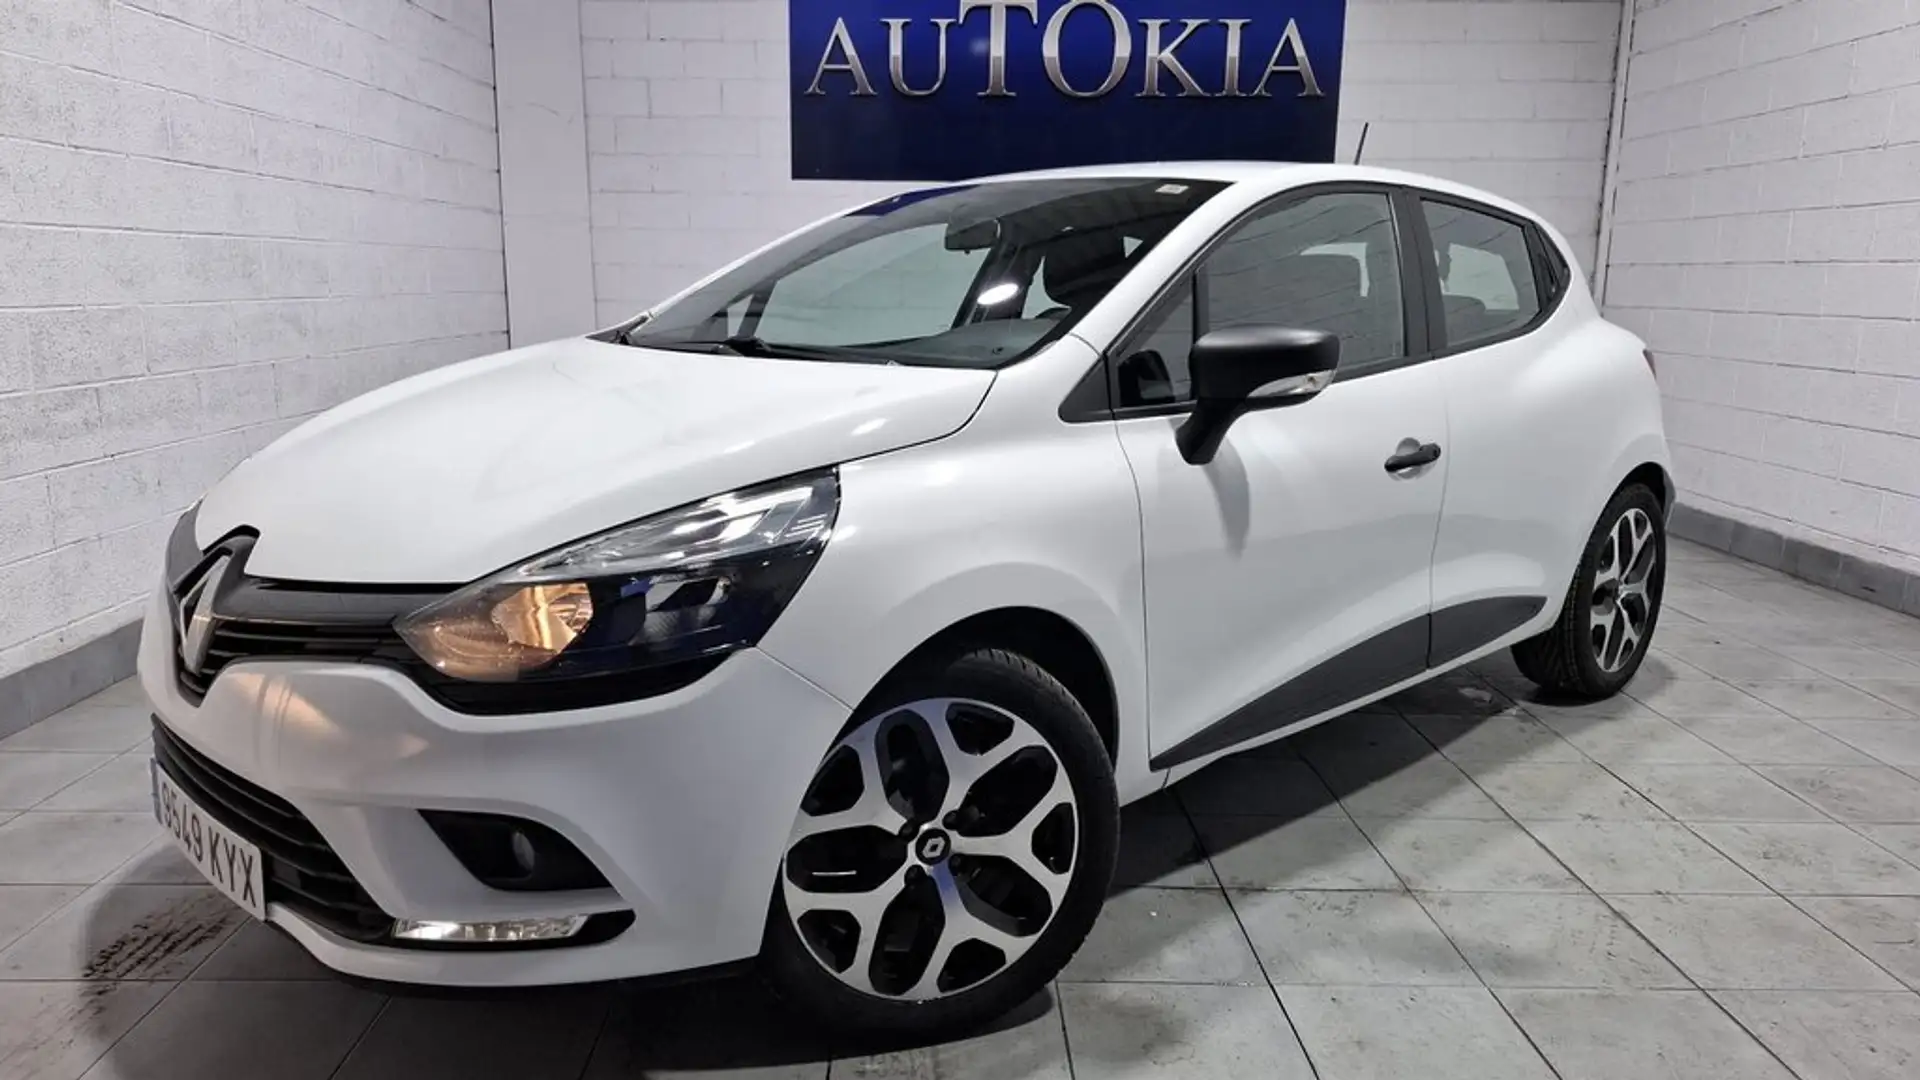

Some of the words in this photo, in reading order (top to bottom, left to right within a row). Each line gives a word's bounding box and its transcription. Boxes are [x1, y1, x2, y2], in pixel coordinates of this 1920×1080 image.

[804, 0, 1323, 97] AUTOKIA
[161, 782, 203, 862] 9549
[208, 826, 256, 908] KYX
